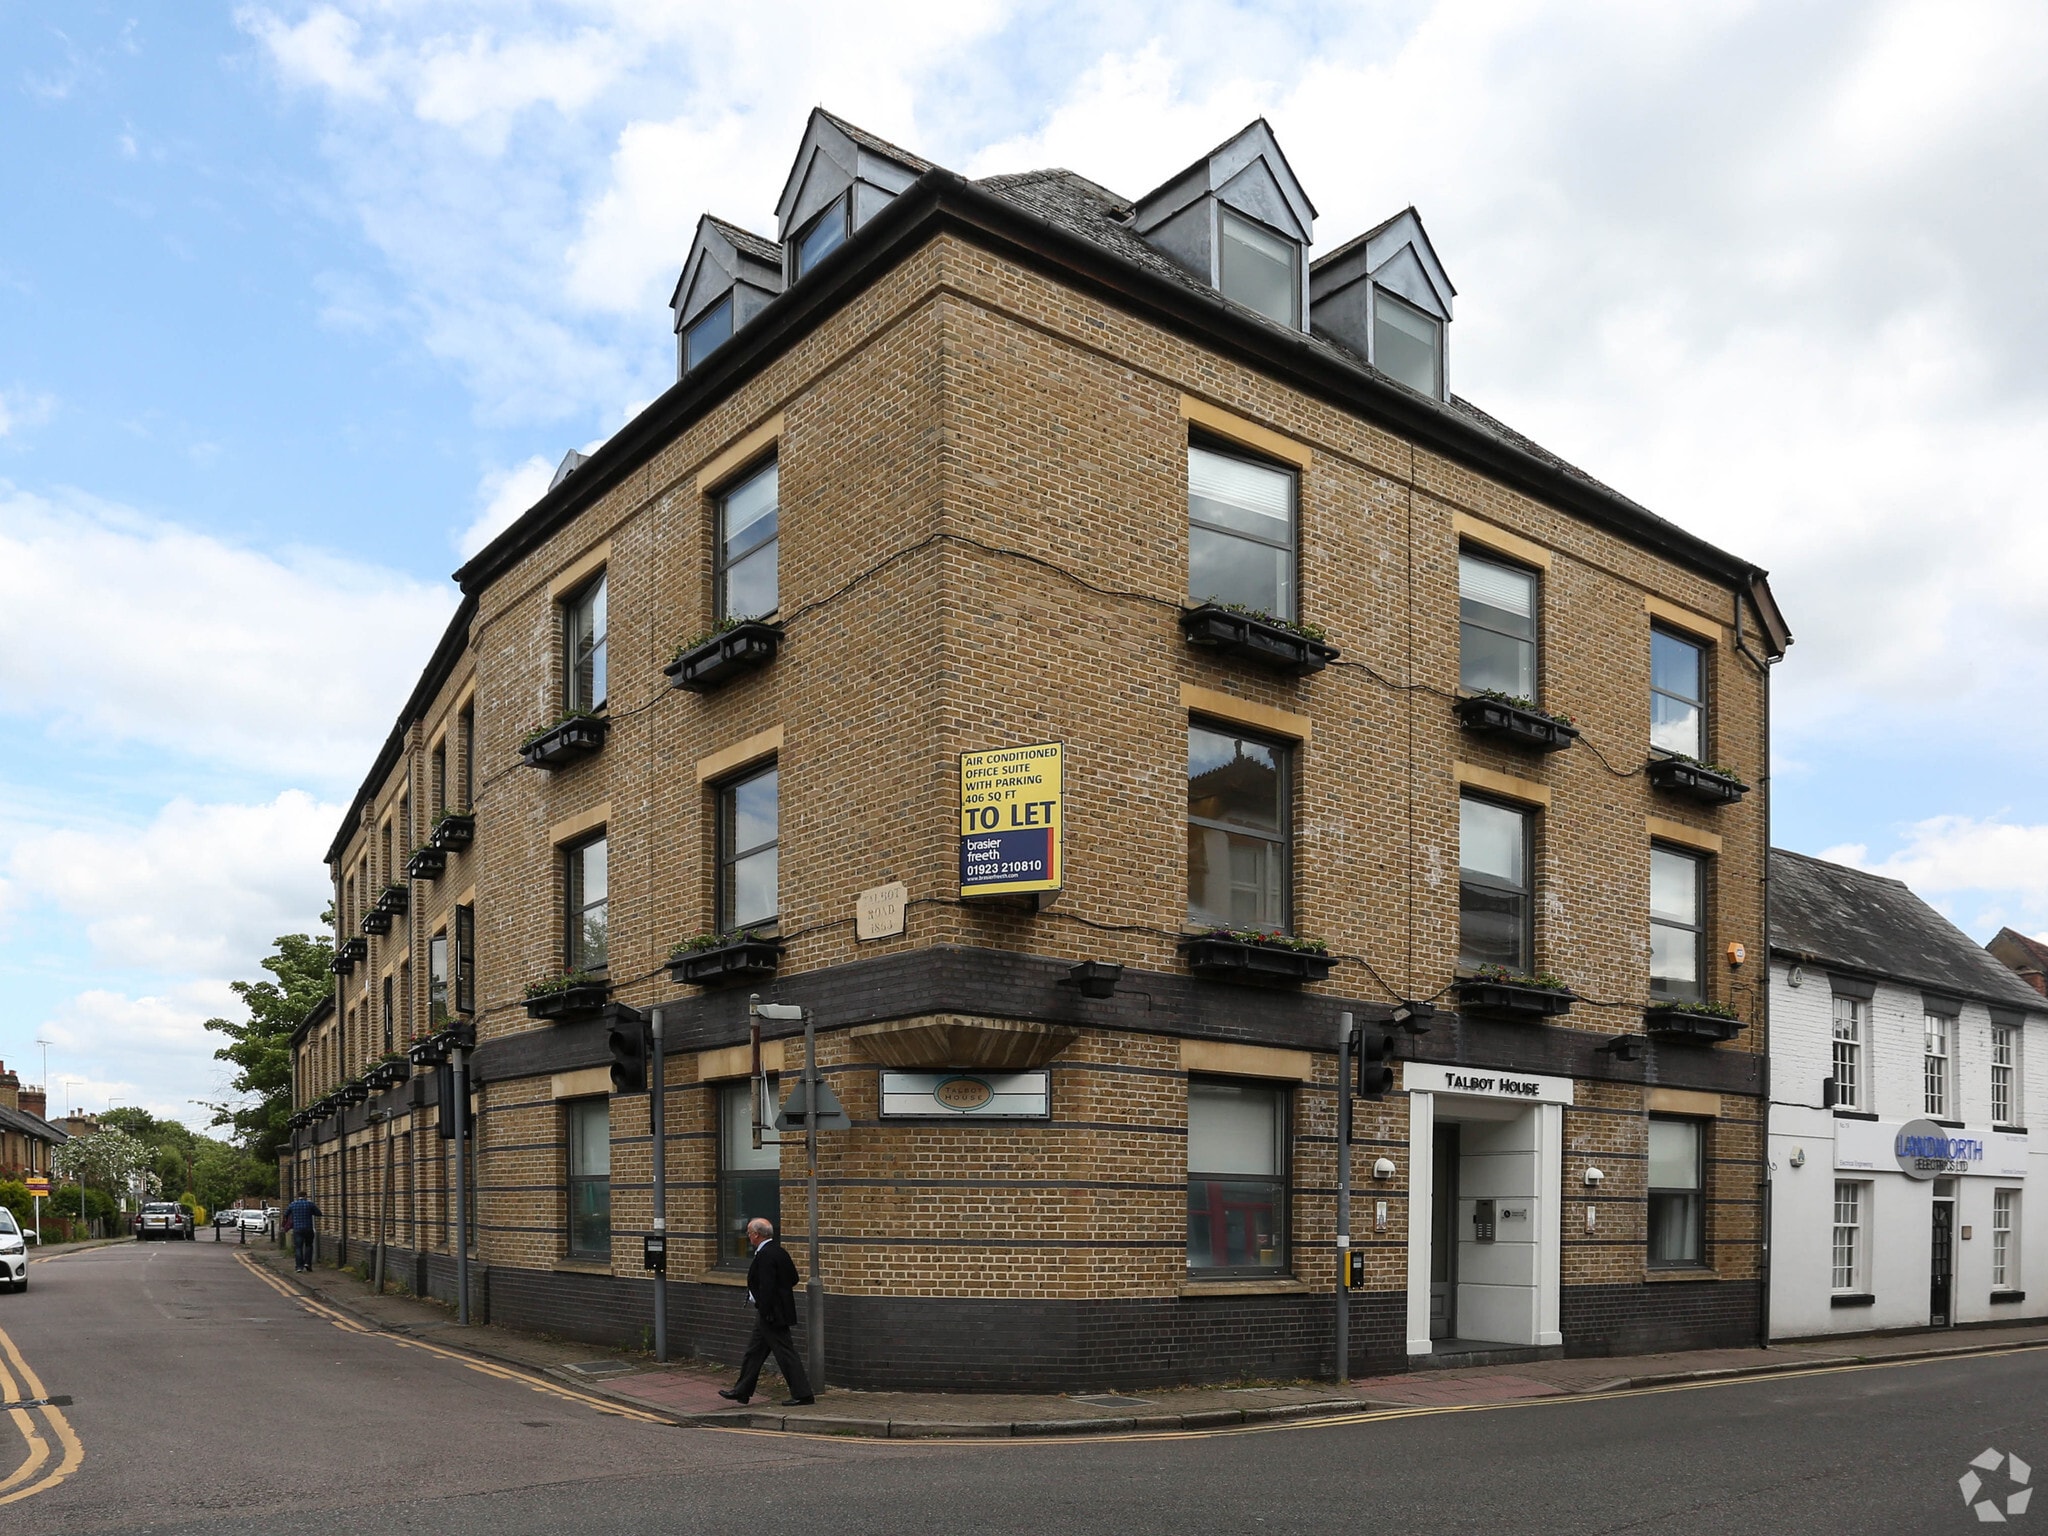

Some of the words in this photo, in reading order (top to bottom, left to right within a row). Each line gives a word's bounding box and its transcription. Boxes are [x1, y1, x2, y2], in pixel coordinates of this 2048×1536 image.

[965, 755, 983, 767] AIR
[986, 747, 1058, 764] CONDITIONED
[965, 766, 999, 779] OFFICE
[1002, 763, 1031, 775] SUITE
[965, 780, 992, 791] WITH
[996, 774, 1042, 788] PARKING
[965, 792, 985, 804] 406
[988, 792, 1002, 803] SQ
[1005, 789, 1017, 800] FT
[965, 806, 999, 831] TO
[1011, 801, 1056, 827] LET
[967, 838, 1002, 851] brasier
[967, 849, 1000, 863] freeth
[967, 863, 999, 876] 01923
[1001, 860, 1042, 873] 210810
[967, 873, 1019, 882] www.brasierfreeth.com
[1445, 1072, 1496, 1091] TALBOT
[1499, 1077, 1540, 1095] HOUSE
[1896, 1134, 1983, 1161] LANDWORTH
[1955, 1160, 1968, 1172] LTD
